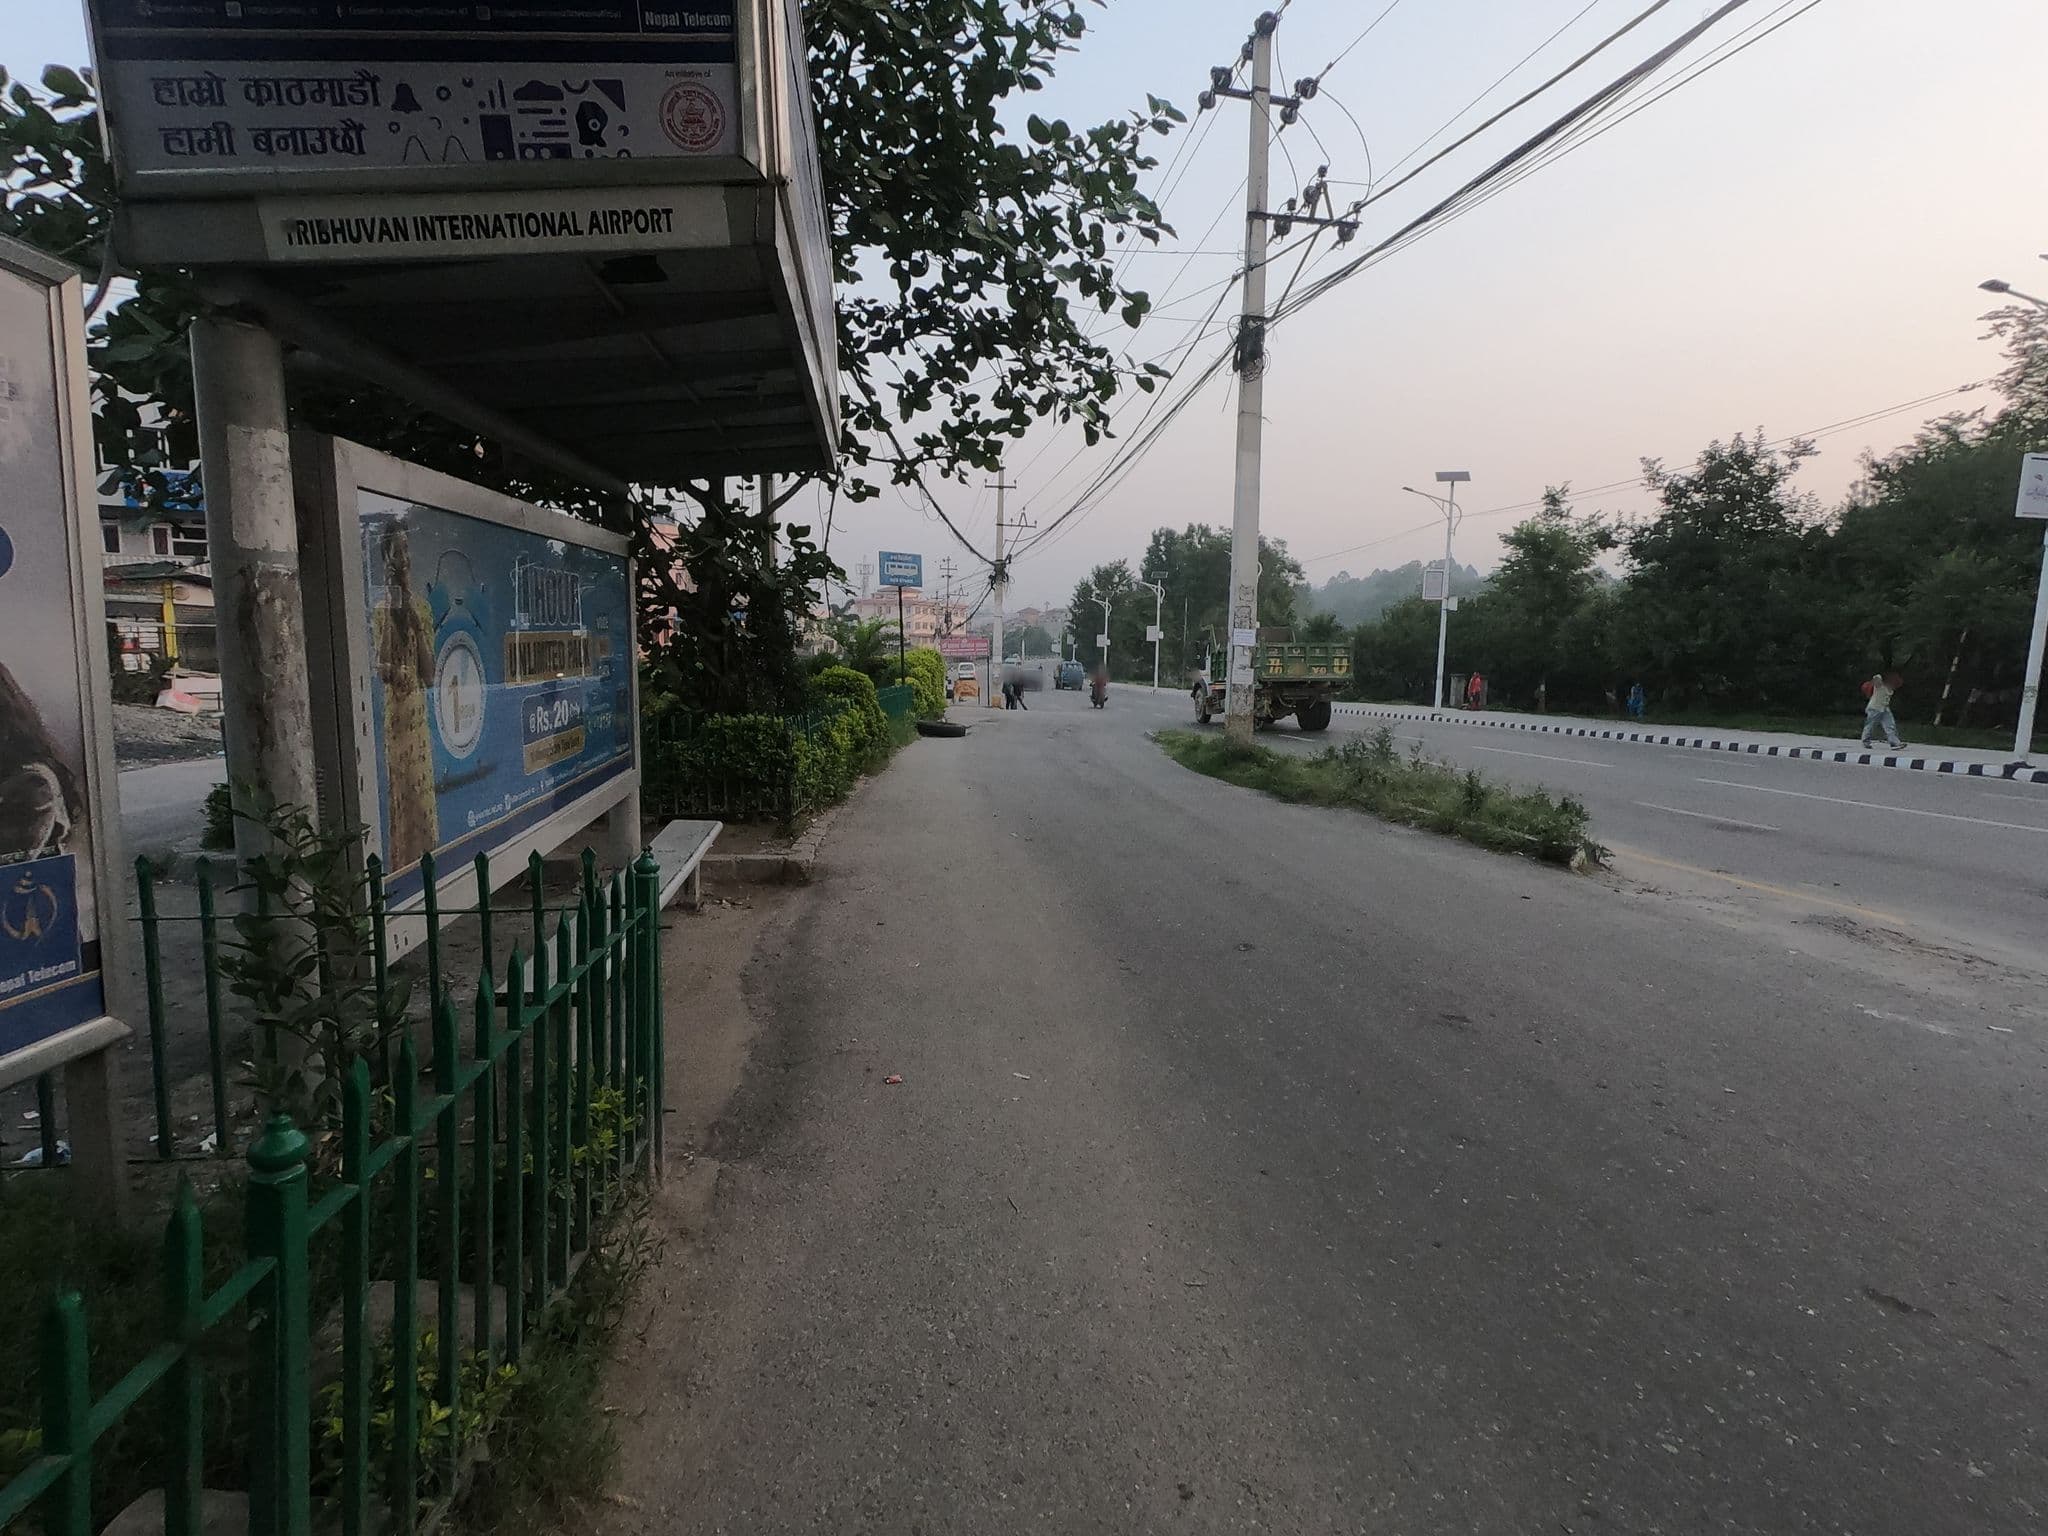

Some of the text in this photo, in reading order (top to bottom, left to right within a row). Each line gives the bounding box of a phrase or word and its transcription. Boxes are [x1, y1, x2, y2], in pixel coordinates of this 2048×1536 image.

[645, 11, 680, 28] Nepal
[682, 12, 732, 28] Telecom
[150, 70, 228, 107] हाम्रो
[158, 120, 238, 156] हामी
[414, 211, 584, 242] INTERNATIONAL
[587, 208, 674, 236] AIRPORT
[0, 960, 77, 993] epal Telecom
